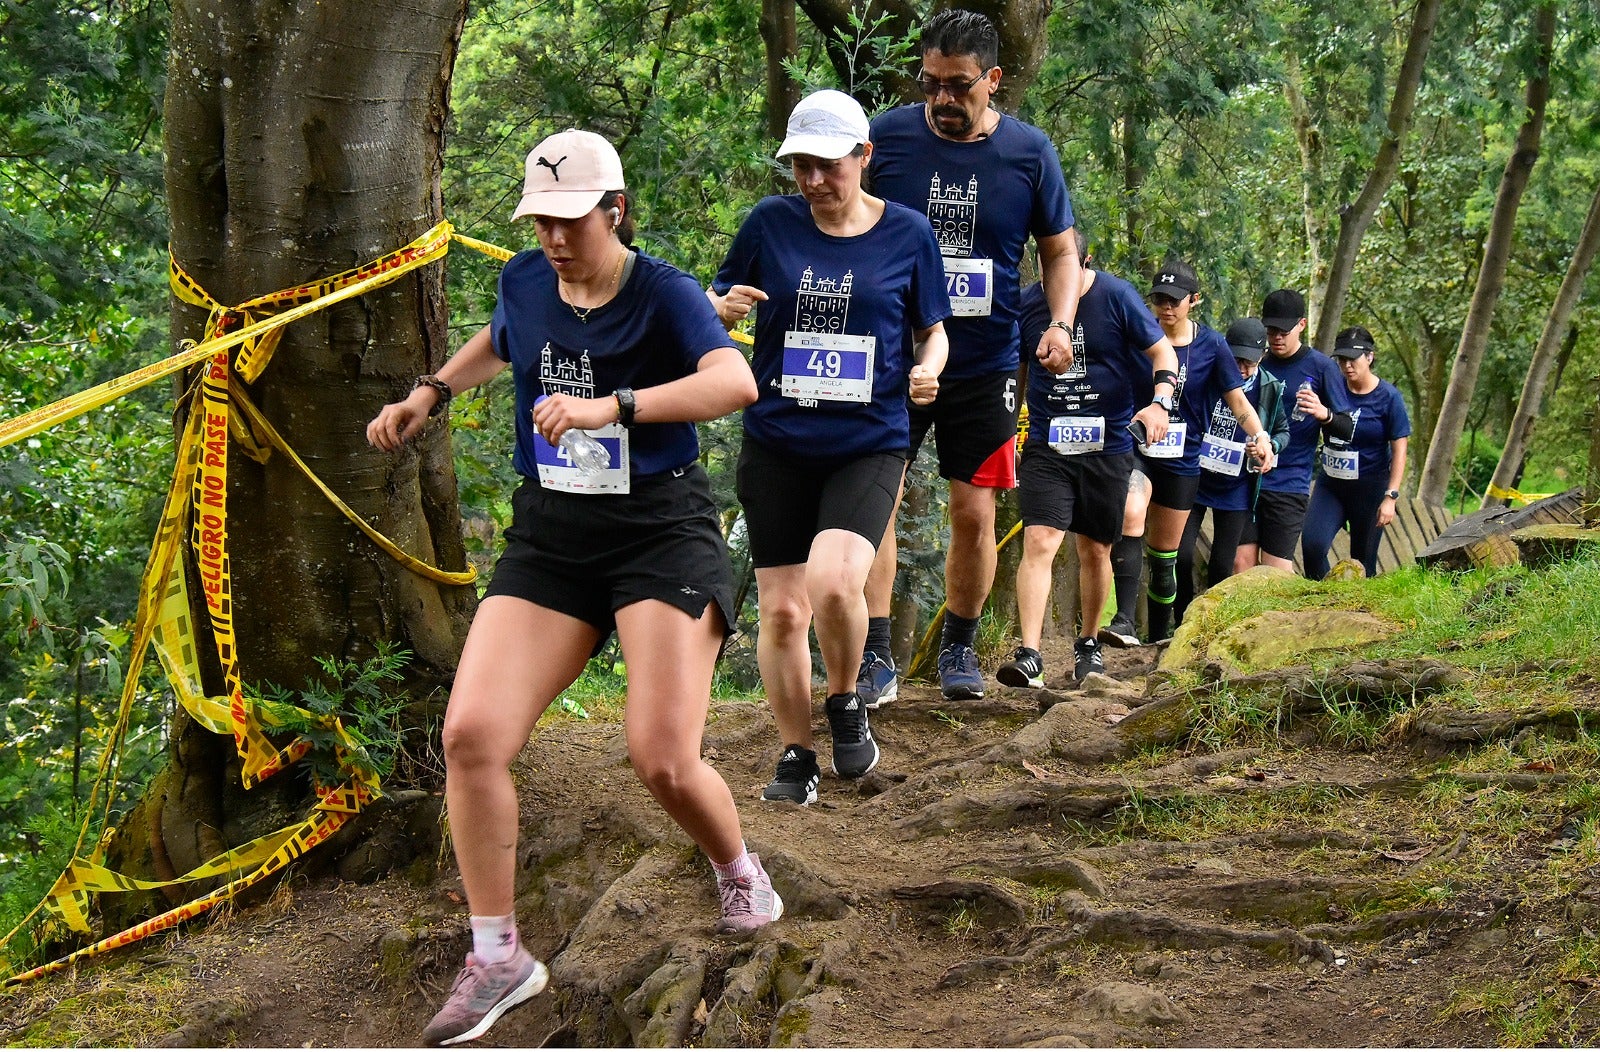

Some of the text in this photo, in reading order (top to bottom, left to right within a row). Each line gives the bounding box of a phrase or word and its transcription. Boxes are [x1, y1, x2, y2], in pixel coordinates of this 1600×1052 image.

[945, 273, 970, 297] 76
[806, 350, 842, 378] 49
[1055, 426, 1093, 443] 1933
[1208, 444, 1232, 464] 521
[1325, 454, 1351, 471] 1842
[202, 413, 226, 610] PELIGRO NO PASE
